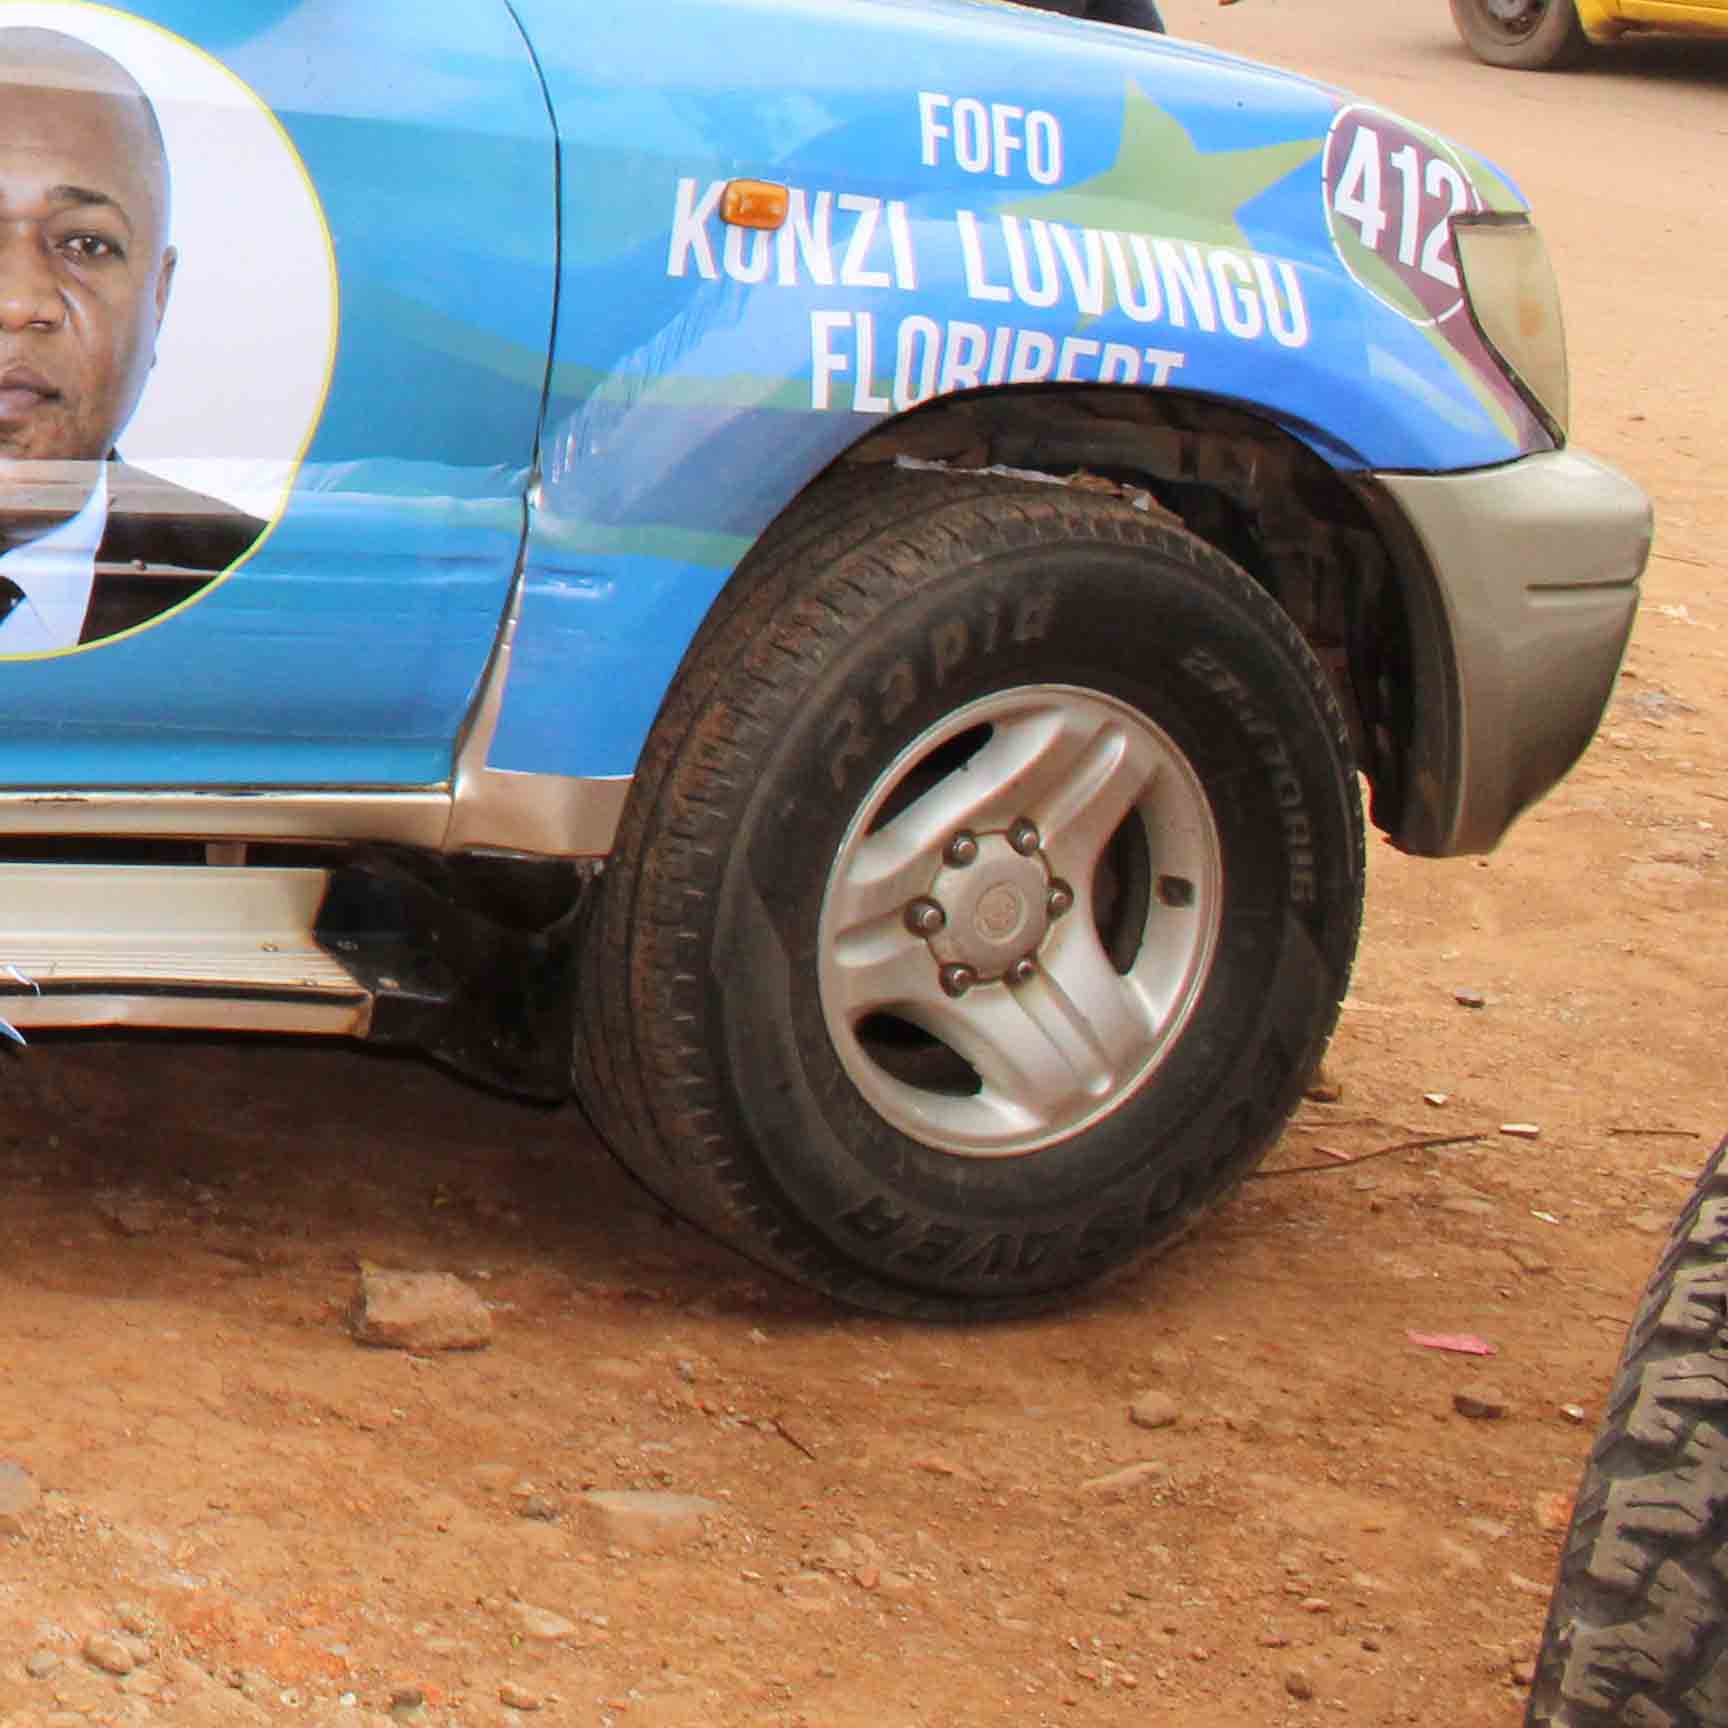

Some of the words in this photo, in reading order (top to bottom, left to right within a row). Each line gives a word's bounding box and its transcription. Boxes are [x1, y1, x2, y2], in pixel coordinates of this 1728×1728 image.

[918, 92, 1064, 184] FOFO
[1334, 125, 1467, 289] 412
[955, 208, 1309, 349] LUVUNGU
